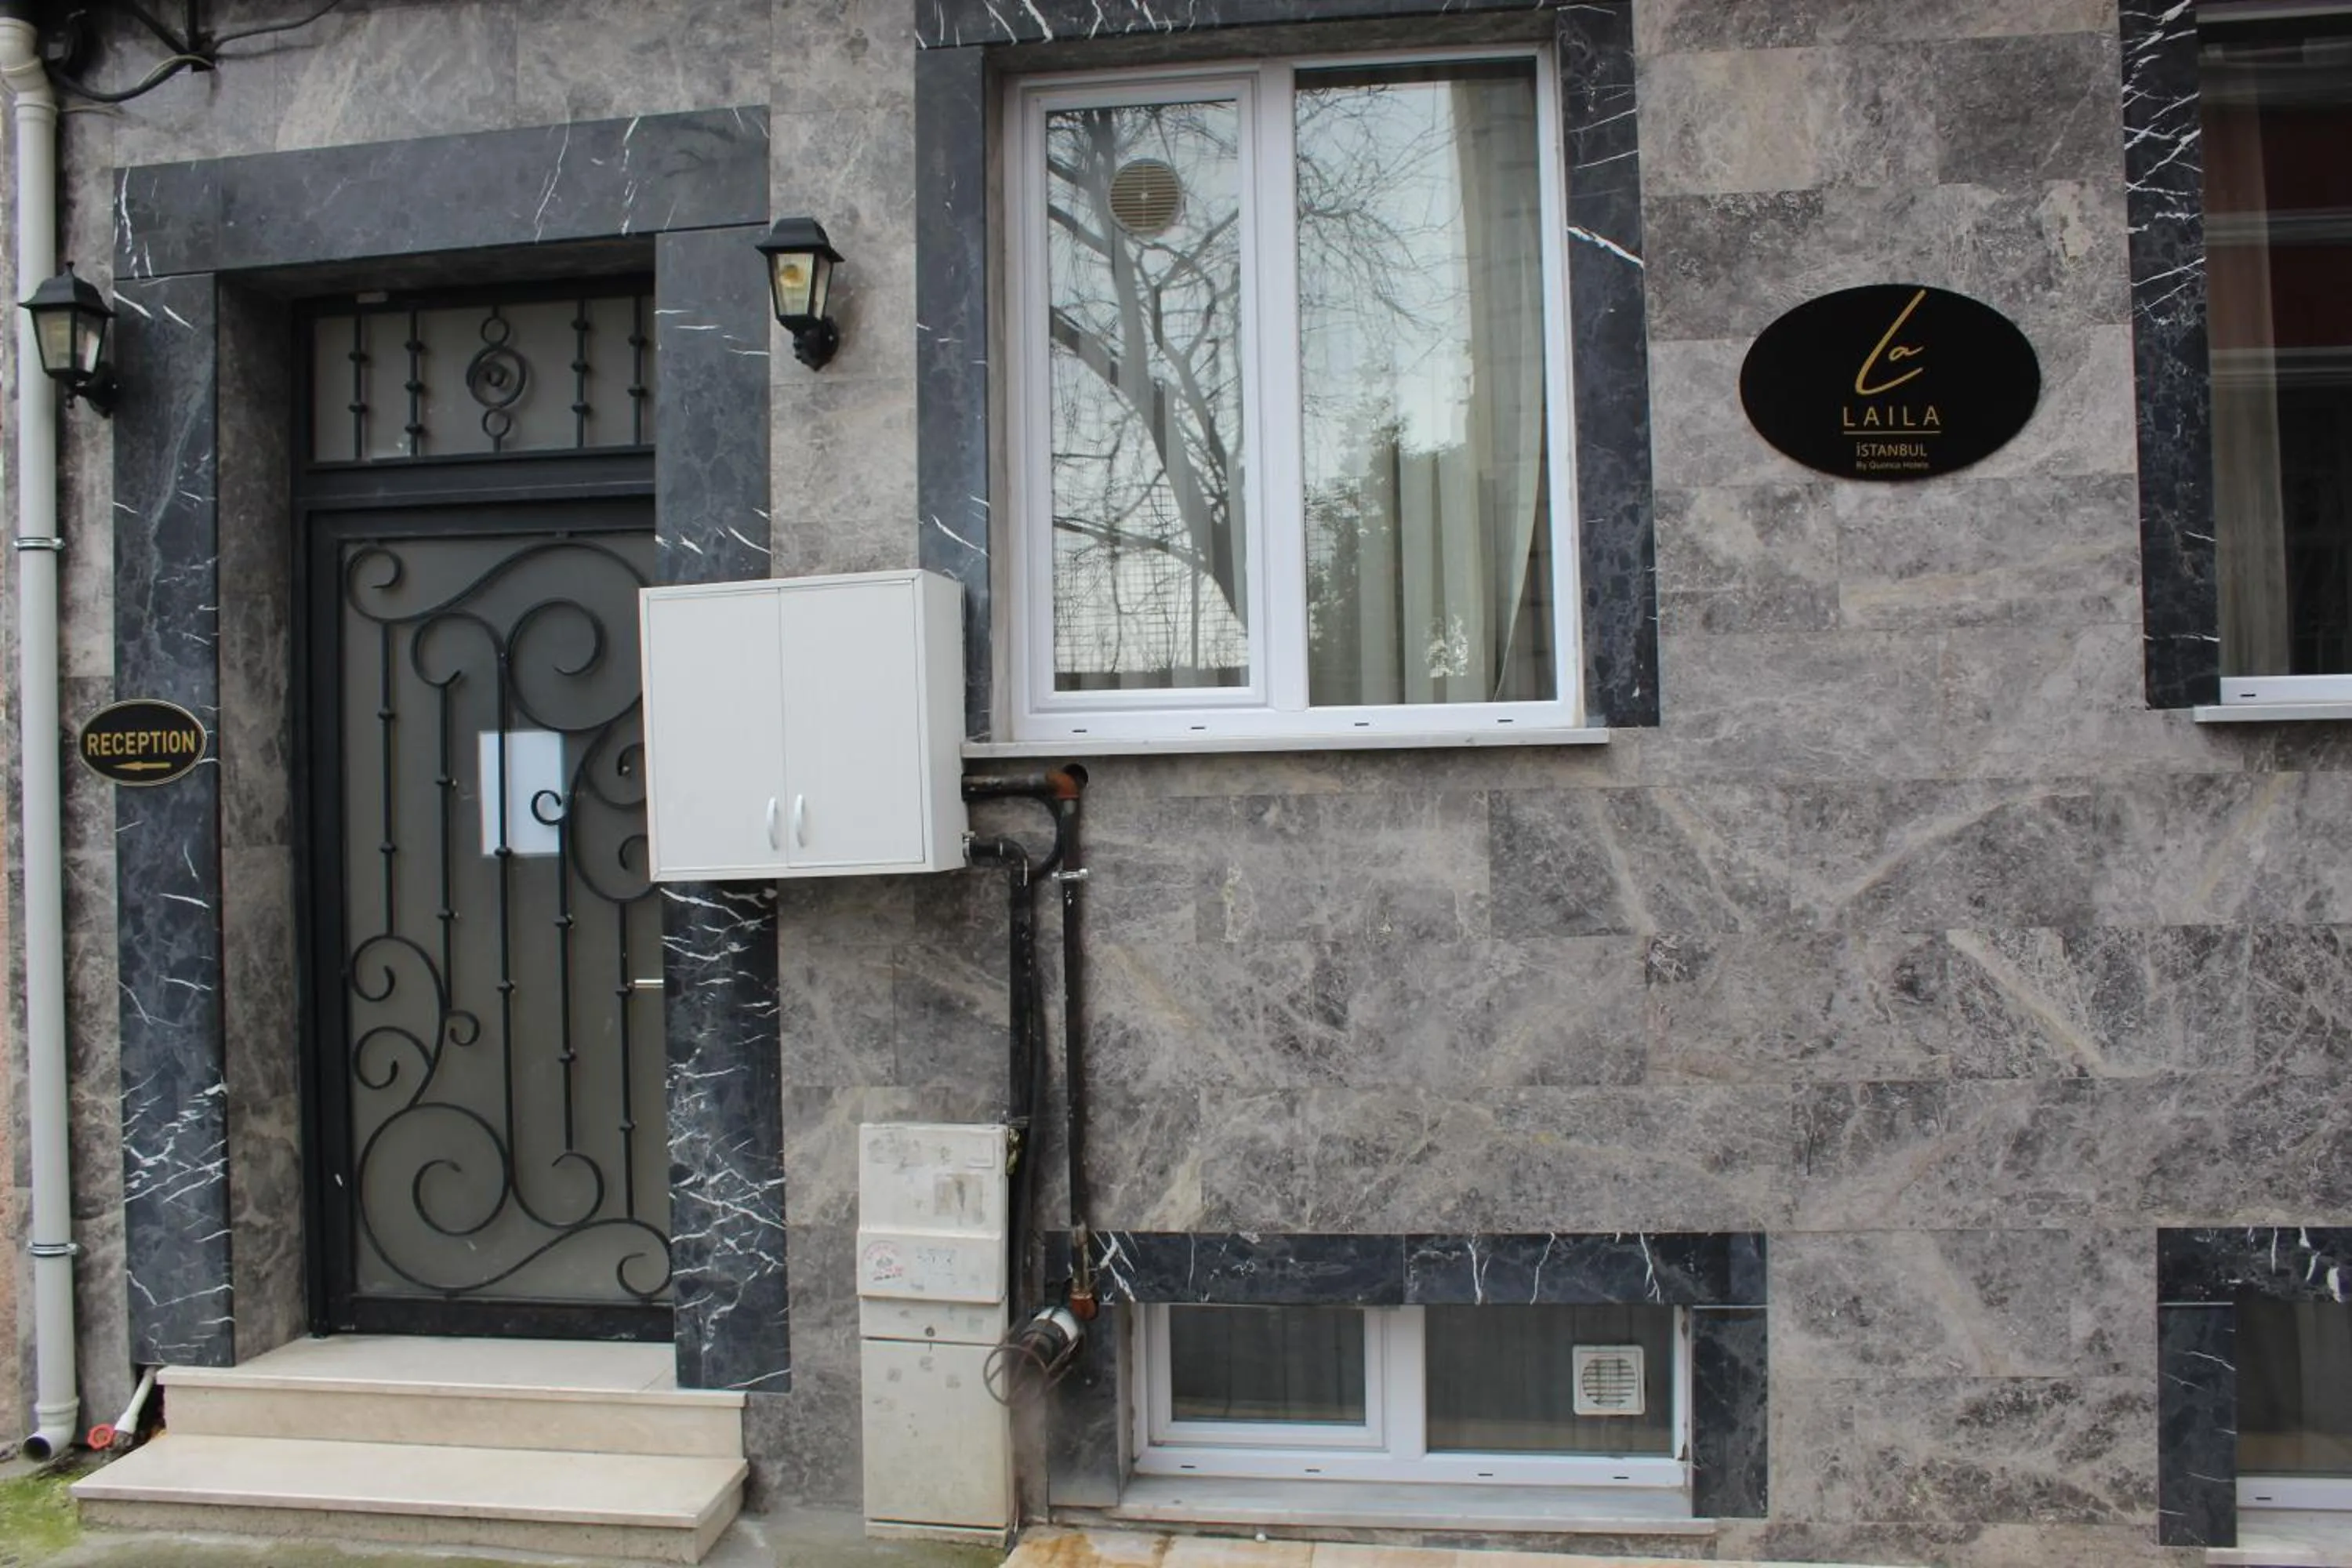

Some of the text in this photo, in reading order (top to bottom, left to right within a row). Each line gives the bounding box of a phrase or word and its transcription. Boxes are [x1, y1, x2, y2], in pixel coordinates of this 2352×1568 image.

[1842, 405, 1940, 427] LAILA
[1856, 441, 1928, 458] İSTANBUL
[87, 730, 196, 756] RECEPTION
